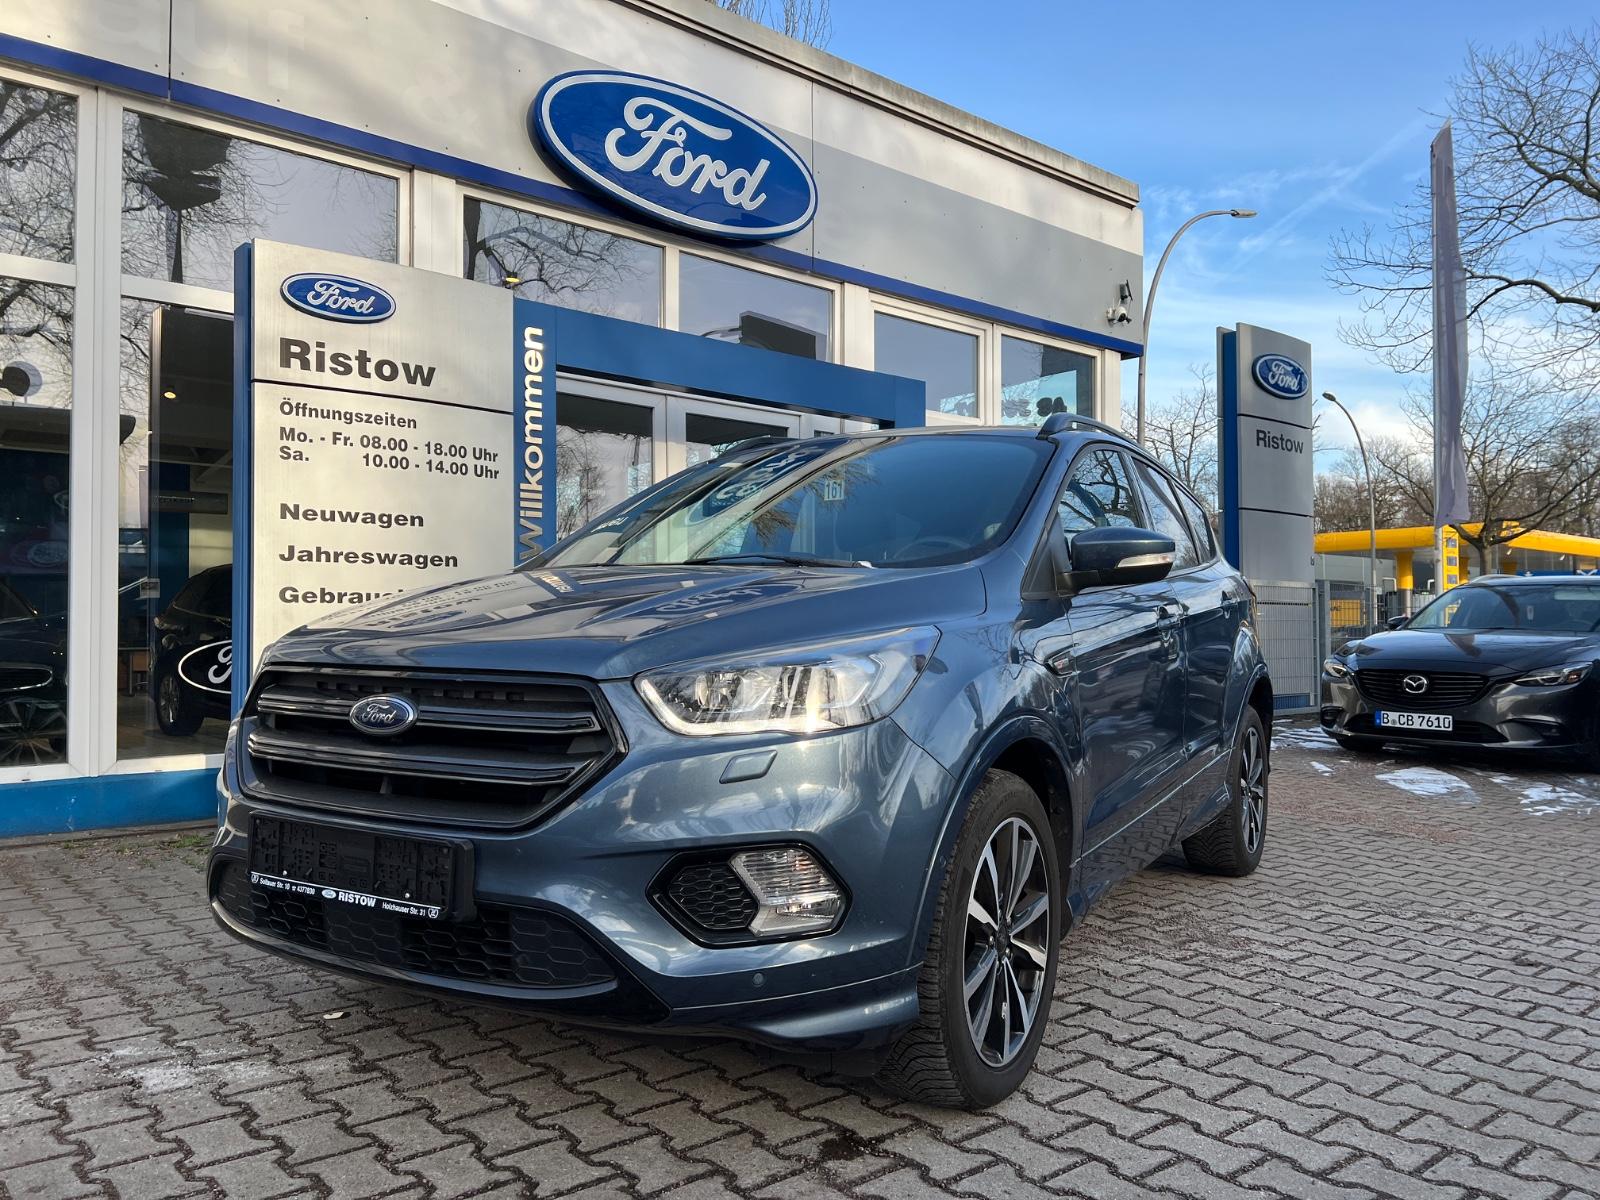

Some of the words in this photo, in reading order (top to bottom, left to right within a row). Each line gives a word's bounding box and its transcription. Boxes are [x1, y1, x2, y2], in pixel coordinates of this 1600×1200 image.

[604, 96, 771, 211] Ford
[306, 280, 376, 314] Ford
[279, 337, 436, 387] Ristow
[1268, 360, 1301, 391] Ford
[279, 397, 417, 429] Öffnungszeiten
[279, 426, 313, 443] Mo.
[332, 431, 354, 447] Fr.
[359, 434, 408, 452] 08.00
[424, 441, 467, 459] 18.00
[472, 446, 499, 463] Uhr
[519, 326, 544, 560] Willkommen
[1256, 429, 1304, 454] Ristow
[279, 445, 310, 462] Sa.
[362, 453, 410, 470] 10.00
[425, 459, 469, 476] 14.00
[473, 464, 500, 480] Uhr
[279, 502, 424, 529] Neuwagen
[279, 545, 458, 570] Jahreswagen
[361, 703, 397, 723] Ford
[1382, 712, 1390, 724] B
[1398, 714, 1415, 726] CB
[1418, 715, 1451, 729] 7610
[338, 891, 377, 908] RISTOW
